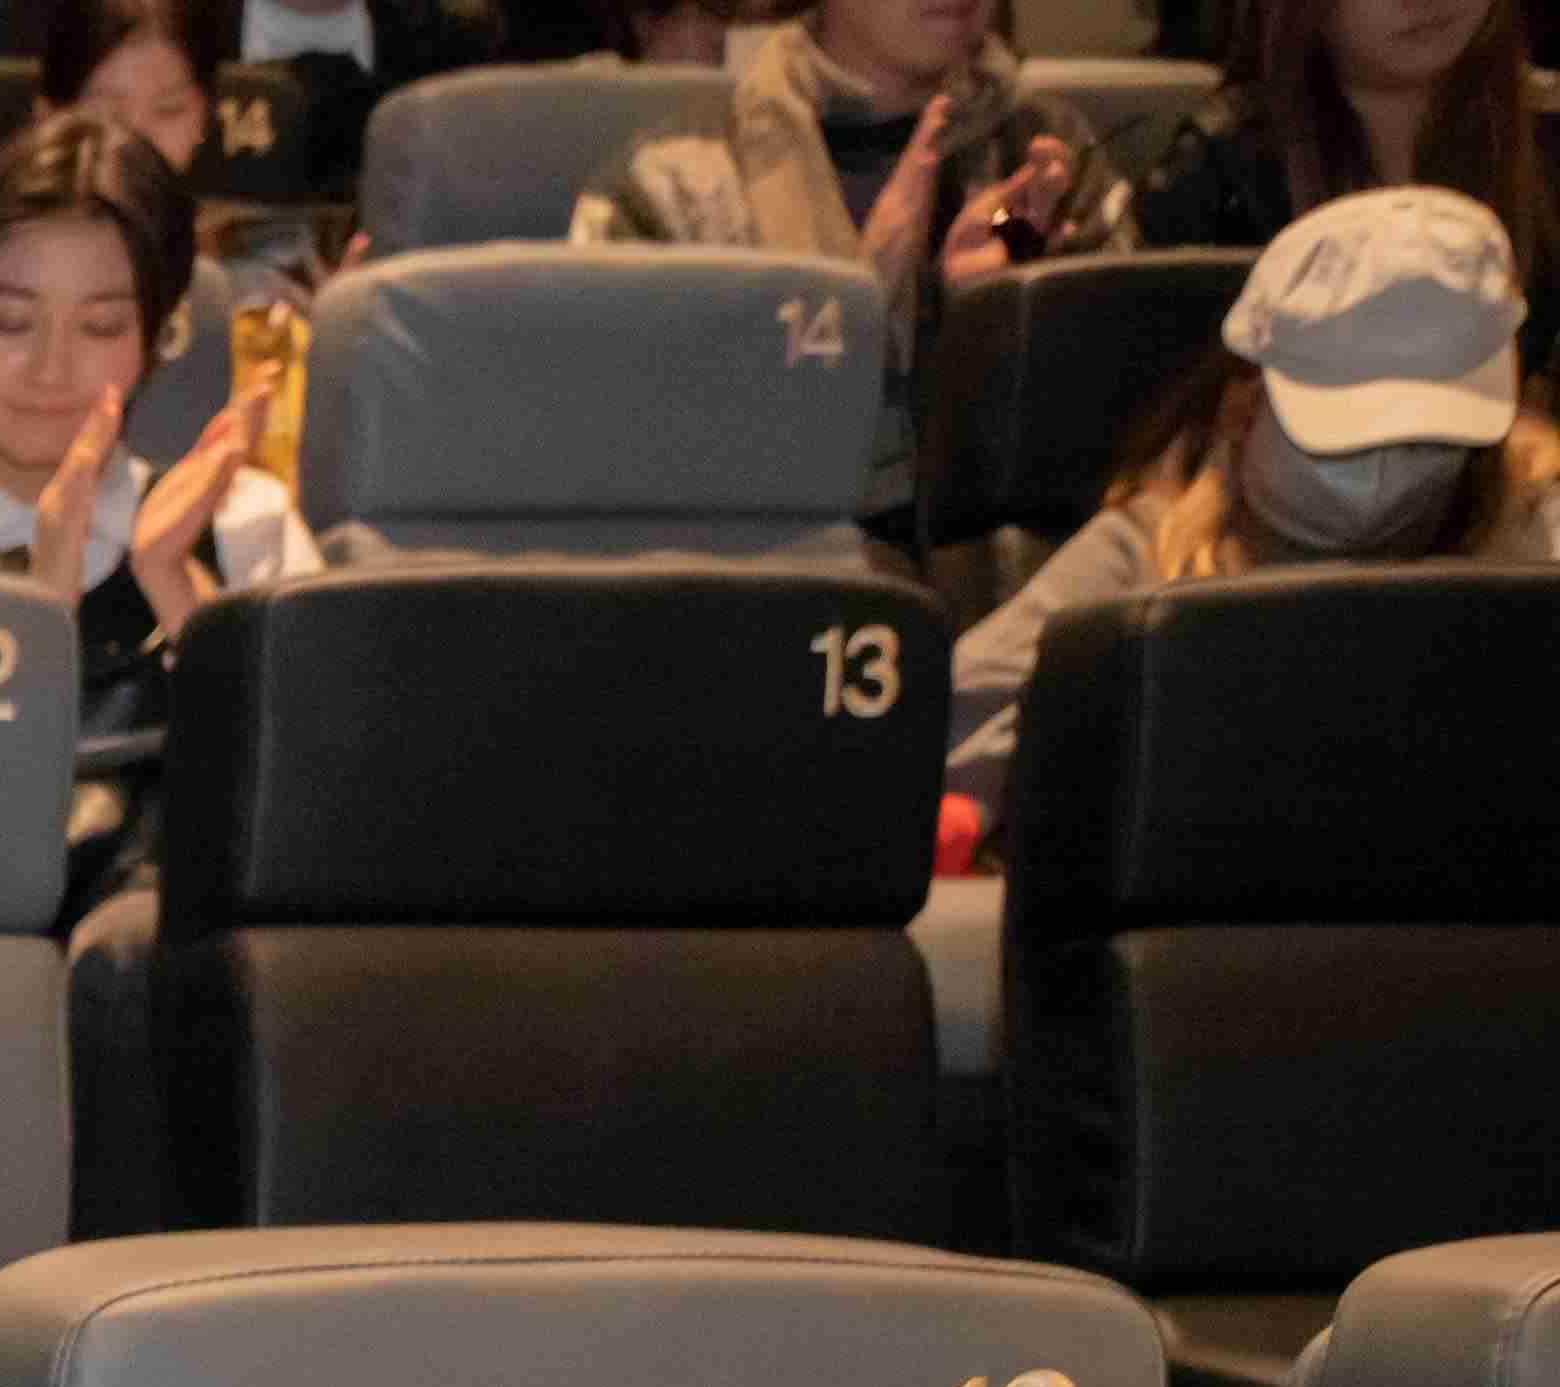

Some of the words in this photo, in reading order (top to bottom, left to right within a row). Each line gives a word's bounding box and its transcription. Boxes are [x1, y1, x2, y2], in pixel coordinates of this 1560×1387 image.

[217, 97, 275, 156] 14
[777, 298, 845, 368] 14
[810, 625, 901, 719] 13
